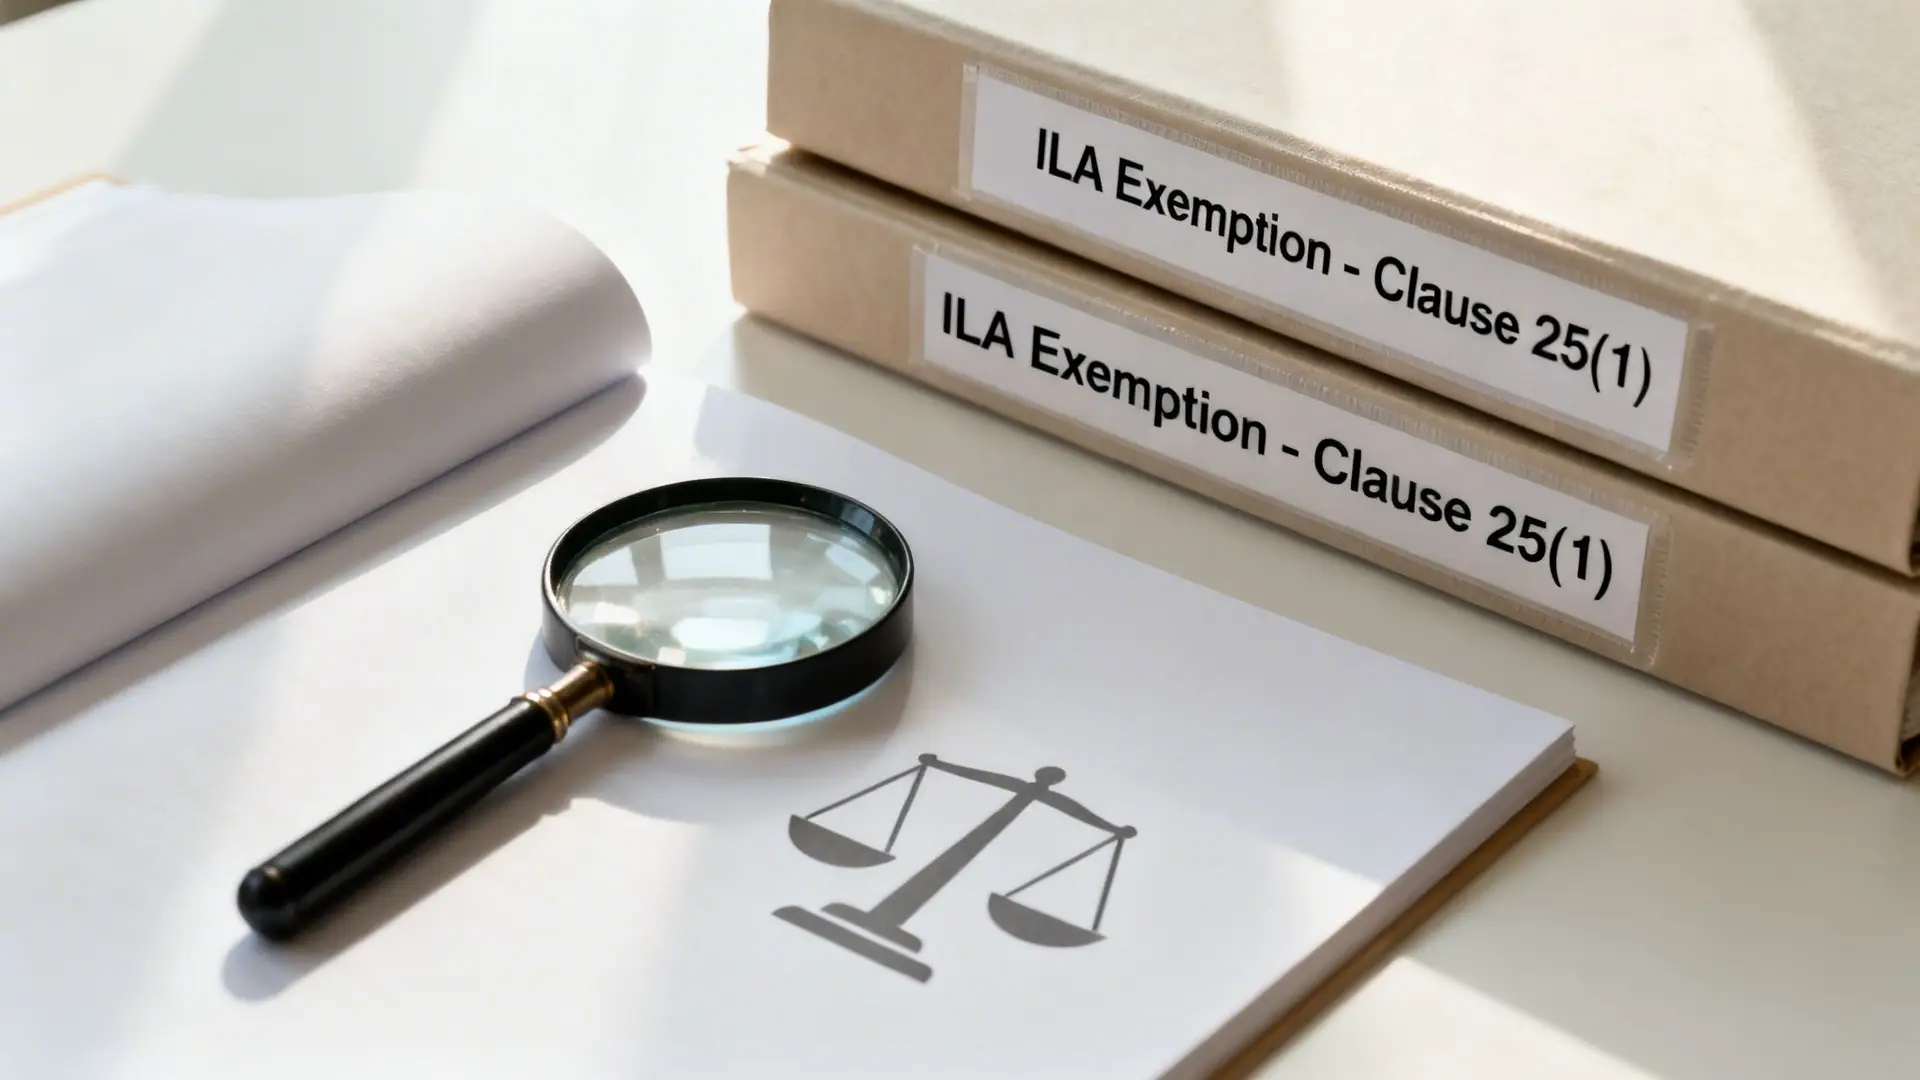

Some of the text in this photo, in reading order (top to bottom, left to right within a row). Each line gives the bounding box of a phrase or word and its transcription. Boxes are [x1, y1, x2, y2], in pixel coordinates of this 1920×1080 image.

[1036, 127, 1651, 408] ILA Exemption - Clause 25(1)
[943, 291, 1613, 601] ILA Exemption - Clause 25(1)
